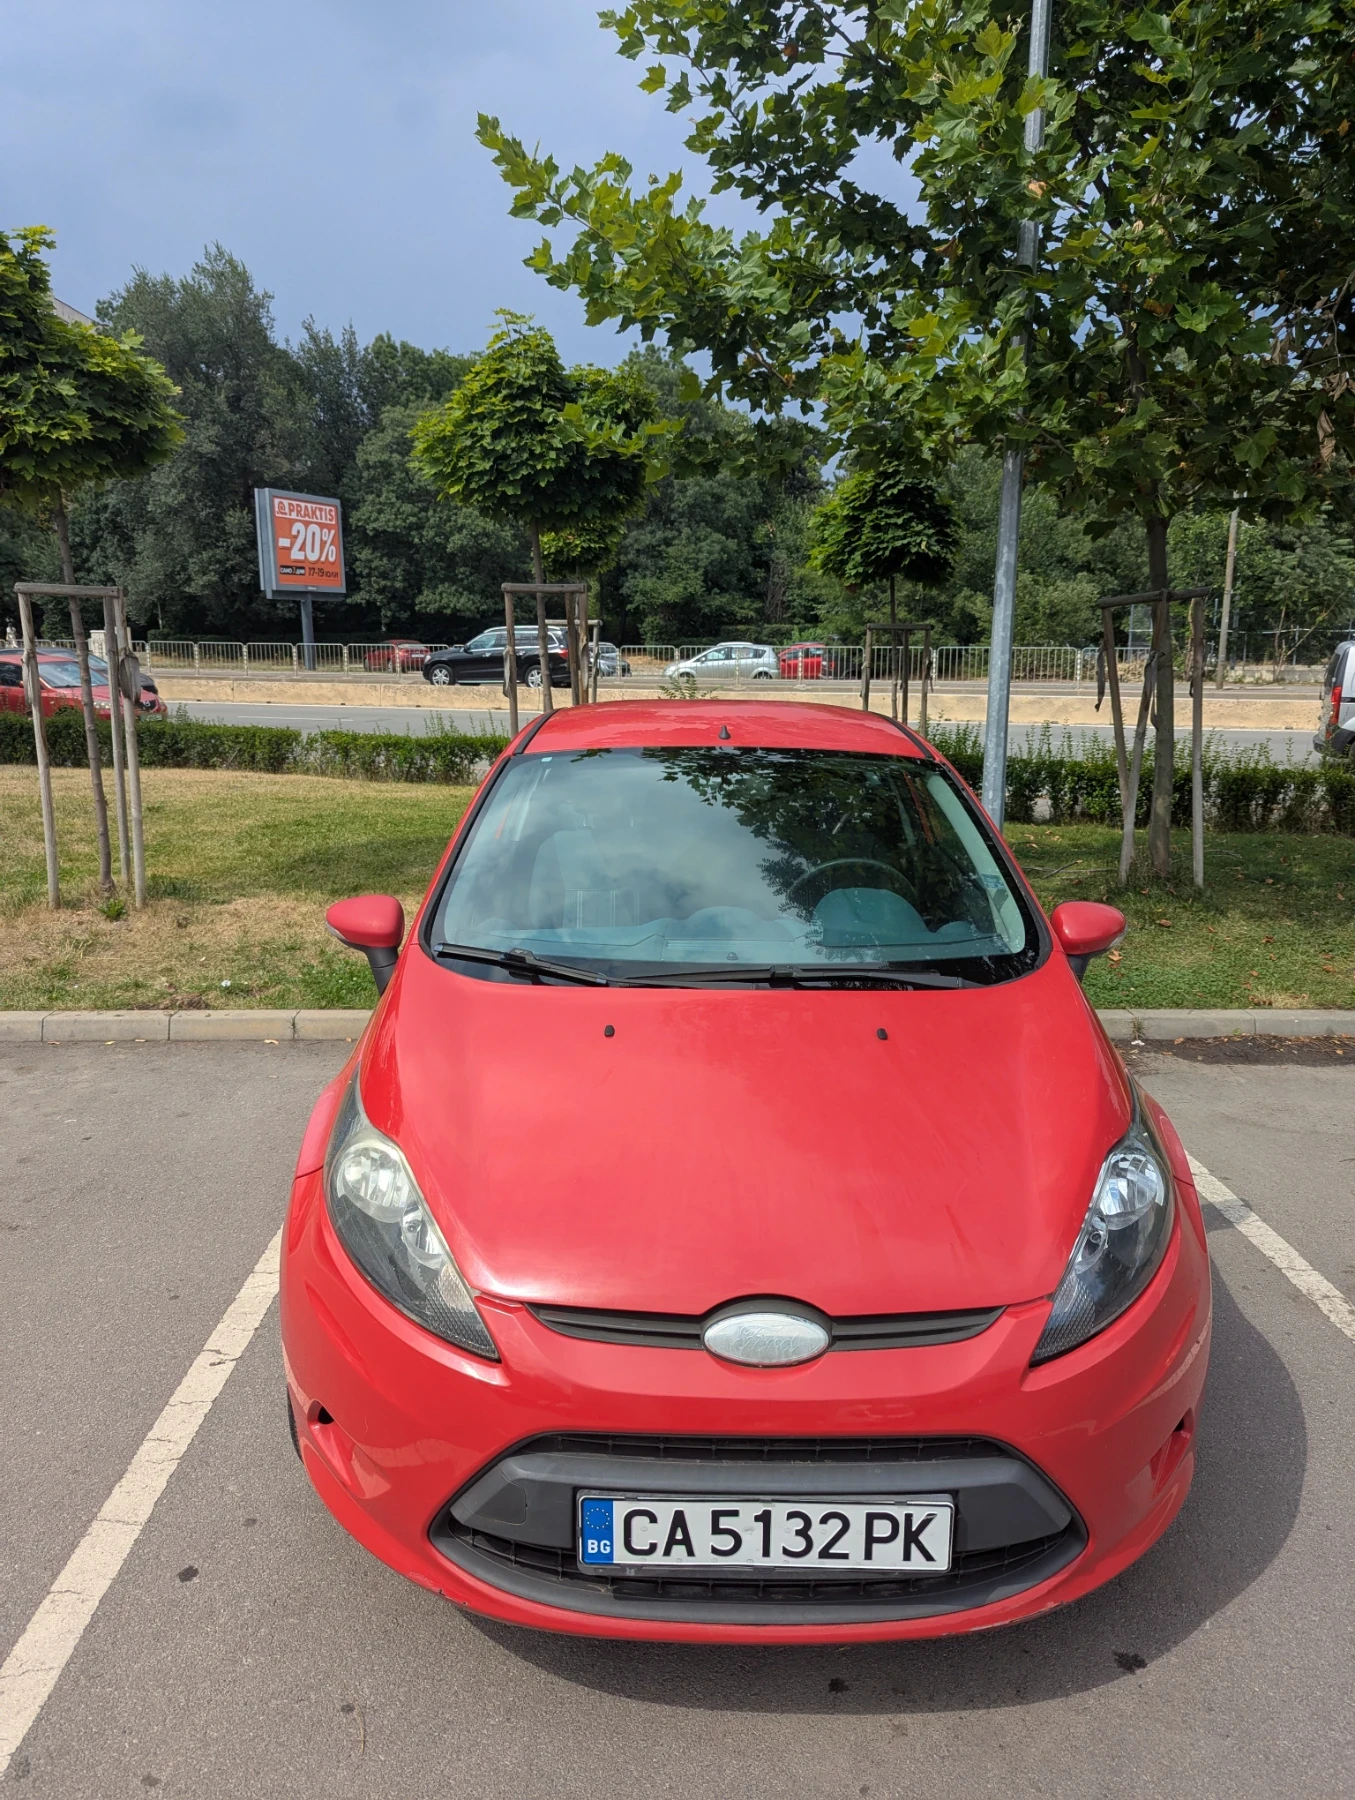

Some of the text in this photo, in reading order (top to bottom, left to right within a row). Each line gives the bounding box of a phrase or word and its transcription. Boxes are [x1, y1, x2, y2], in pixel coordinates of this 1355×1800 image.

[288, 502, 334, 523] PRAKTIS
[278, 522, 337, 563] -20%
[308, 567, 324, 577] 17-19
[587, 1539, 611, 1555] BG
